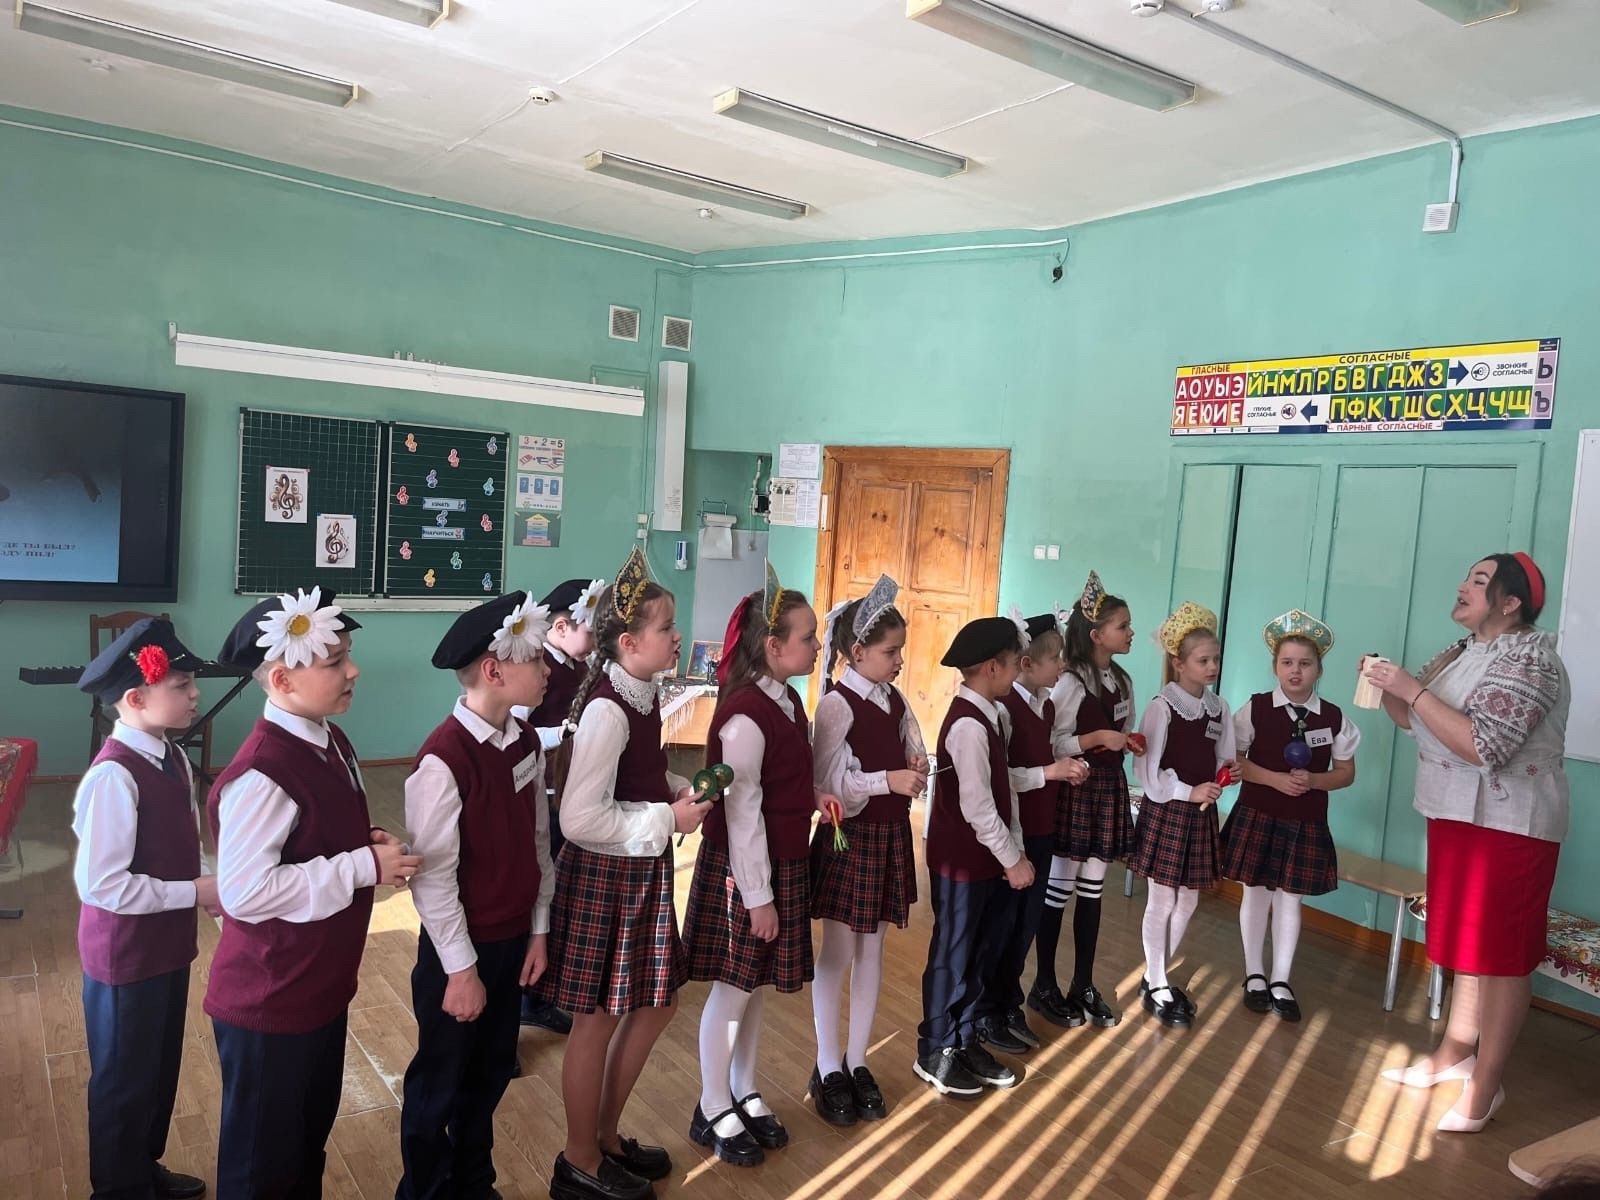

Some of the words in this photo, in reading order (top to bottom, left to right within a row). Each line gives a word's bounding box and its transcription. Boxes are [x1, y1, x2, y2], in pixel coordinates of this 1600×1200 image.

[1339, 351, 1411, 364] СОГЛАСНЫЕ
[1191, 364, 1231, 375] ГЛАСНЫЕ
[1496, 362, 1528, 370] ЗВОНКИЕ
[1492, 368, 1534, 377] СОГЛАСНЫЕ
[1336, 423, 1373, 432] ПАРНЫЕ
[1377, 422, 1433, 431] СОГЛАСНЫЕ
[1311, 736, 1327, 745] Ева
